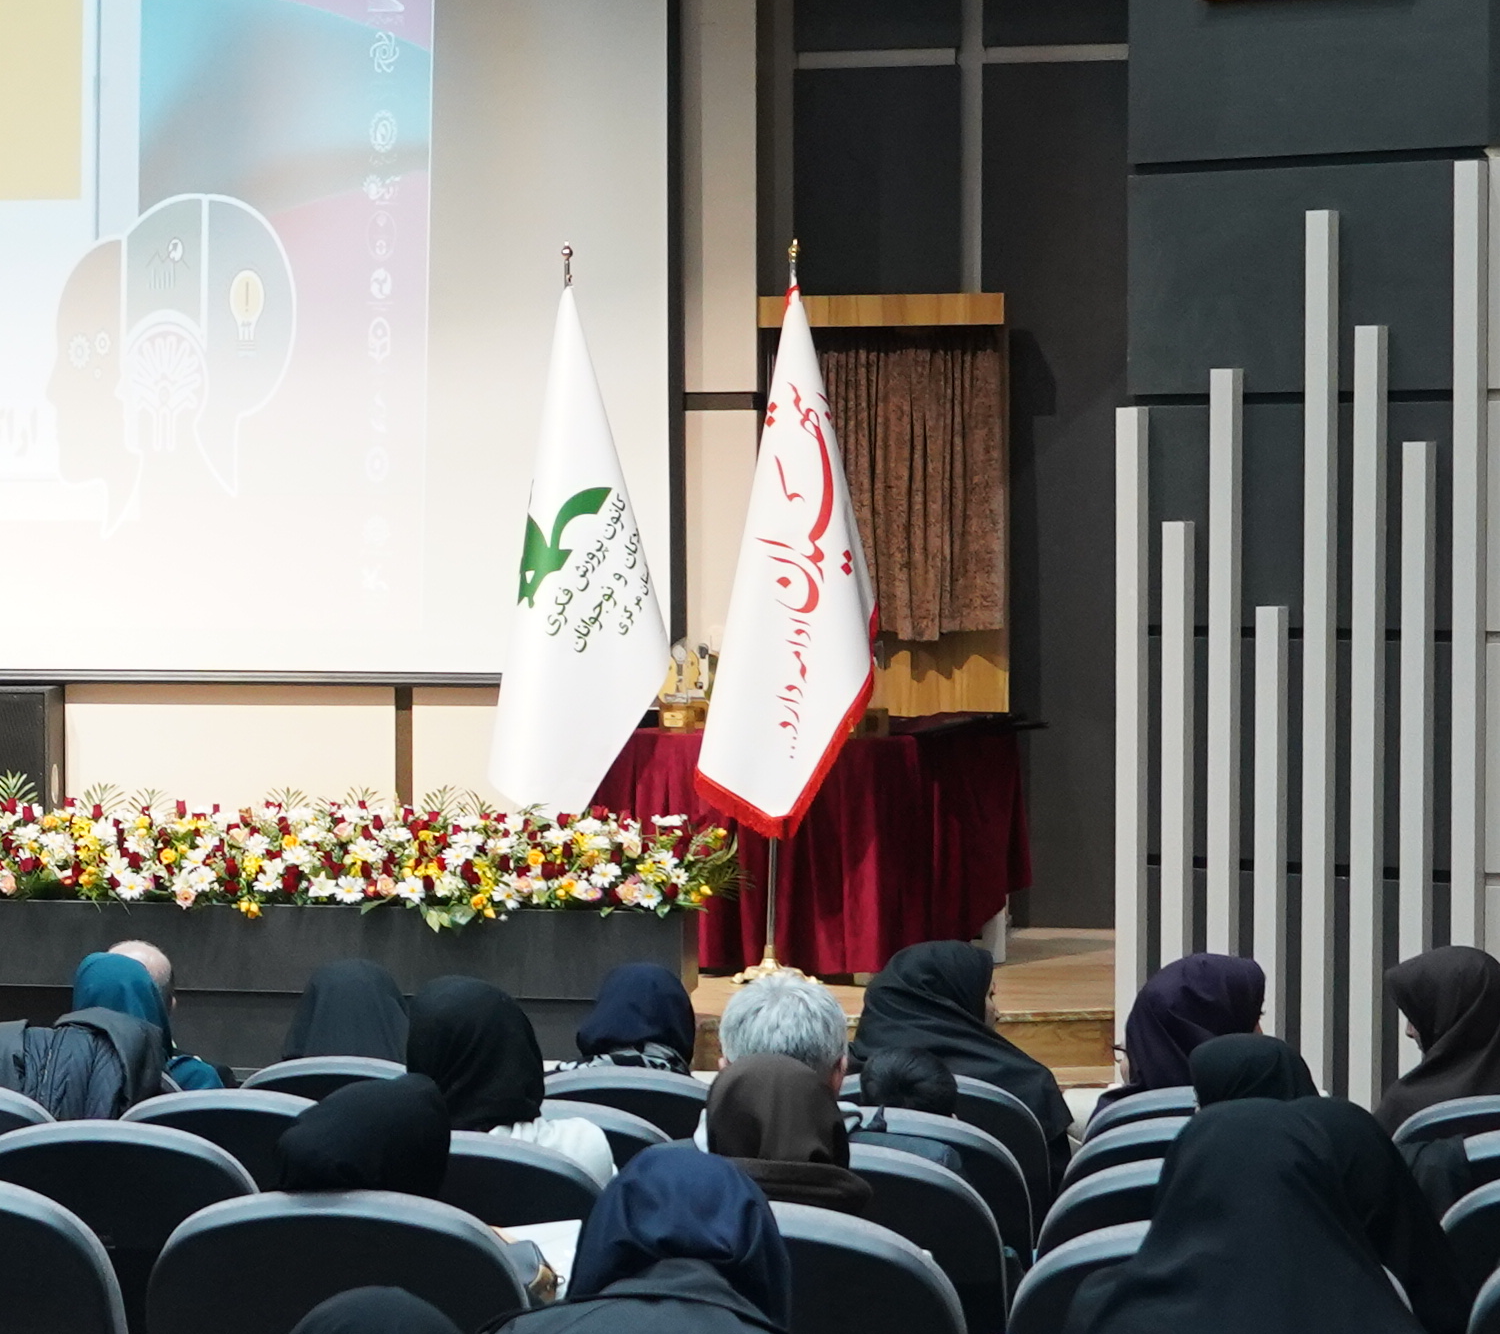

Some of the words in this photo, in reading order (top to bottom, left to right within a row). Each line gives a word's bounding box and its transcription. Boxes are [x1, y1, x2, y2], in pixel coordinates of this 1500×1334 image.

[603, 493, 626, 541] کانون
[575, 539, 610, 592] پرورش
[545, 586, 575, 637] فکری
[574, 586, 617, 653] نوجوانان
